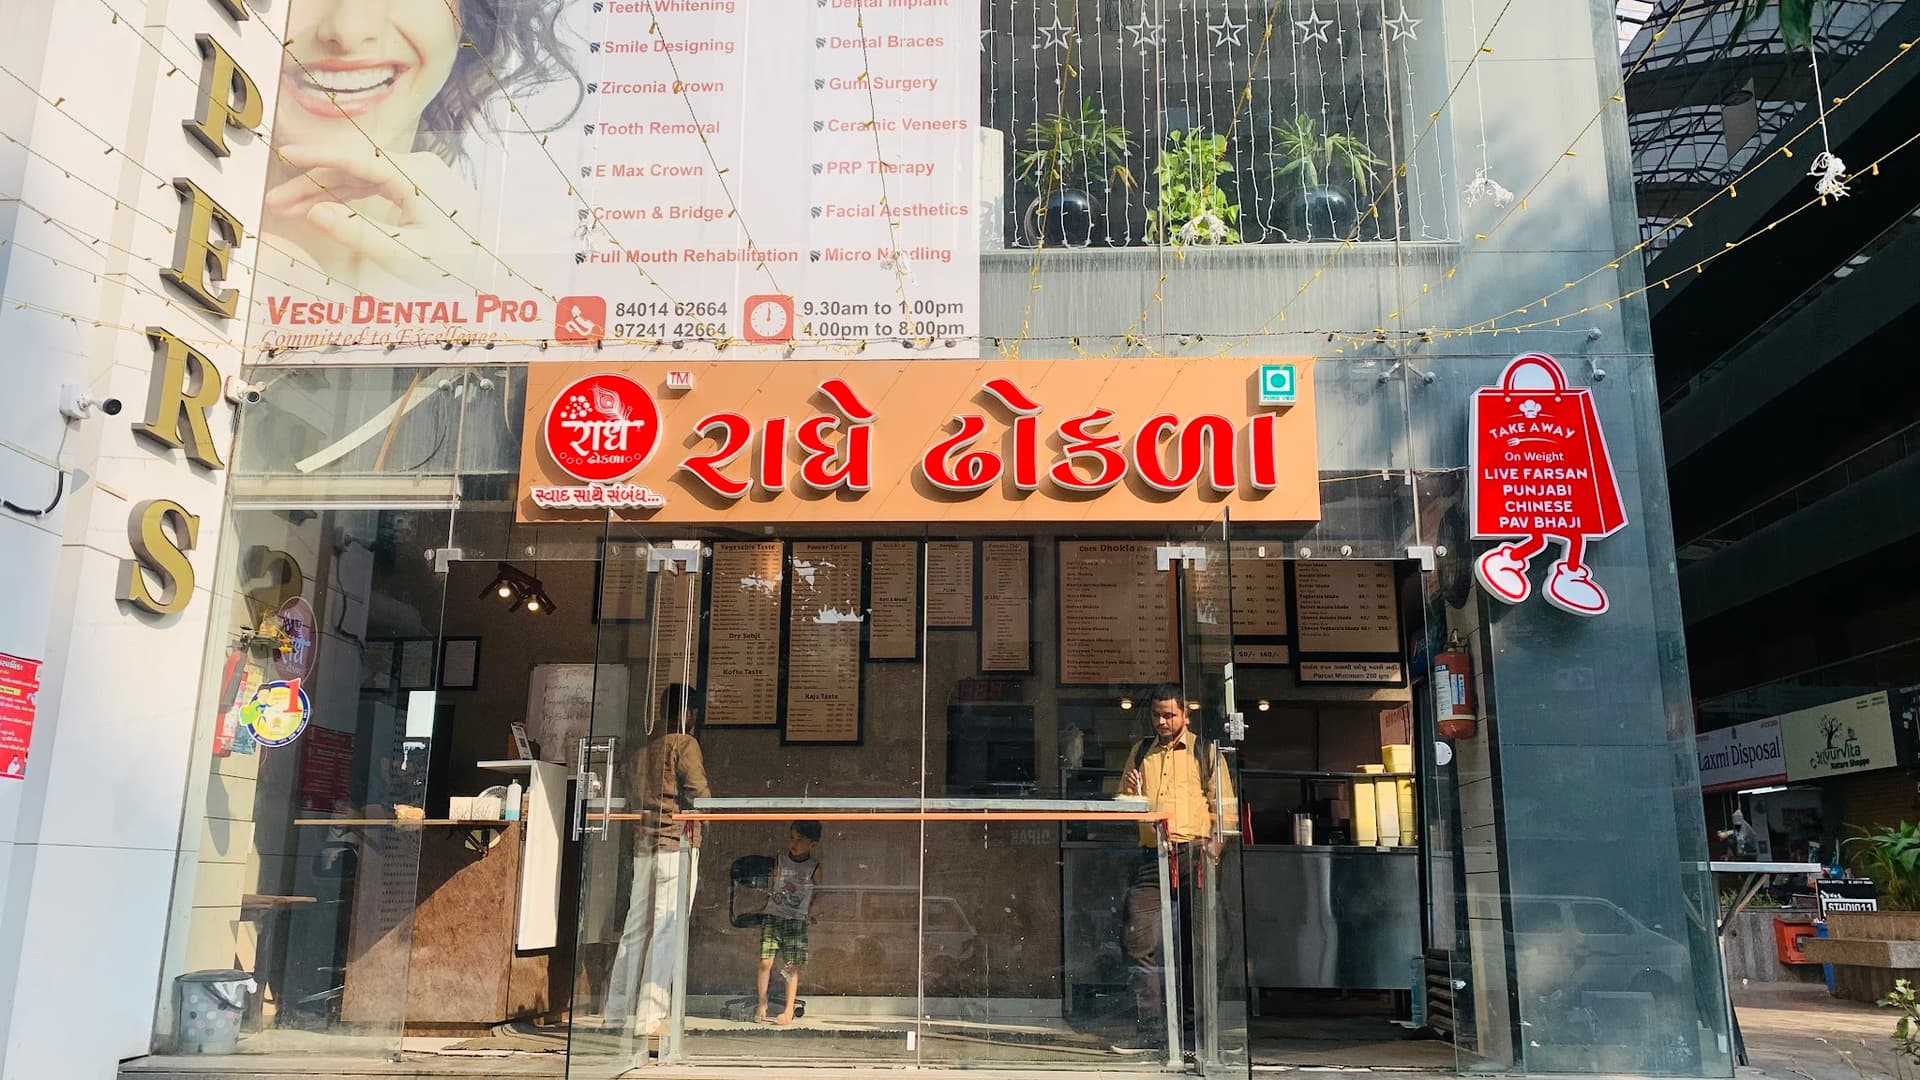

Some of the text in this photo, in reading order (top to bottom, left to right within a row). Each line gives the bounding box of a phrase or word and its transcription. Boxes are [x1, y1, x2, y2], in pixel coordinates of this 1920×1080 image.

[608, 0, 735, 14] Teeth Whitening
[831, 0, 948, 10] Dental Implant
[604, 39, 735, 55] Smile Designing
[830, 35, 944, 48] Dental Braces
[601, 81, 667, 95] Zirconia
[829, 76, 938, 92] Gum Surgery
[599, 121, 720, 136] Tooth Removal
[828, 118, 968, 132] Ceramic Veneers
[596, 164, 704, 177] E Max Crown
[827, 161, 936, 176] PRP Therapy
[593, 206, 724, 222] Crown & Bridge
[826, 203, 969, 218] Facial Aesthetics
[590, 248, 798, 263] Full Mouth Rehabilitation
[825, 247, 951, 263] Micro Ndling
[615, 302, 728, 317] 84014 62664
[804, 300, 964, 318] 9.30am to 1.00pm
[261, 326, 368, 347] Committed
[614, 322, 727, 338] 97241 42664
[804, 321, 965, 338] 4.00pm to 8.00pm
[670, 372, 689, 384] TM
[679, 377, 1279, 499] રાધે ઢોકળા
[1489, 422, 1576, 440] TAKE AWAY
[1504, 451, 1564, 464] On Weight
[1484, 468, 1588, 480] LIVE FARSAN
[535, 488, 570, 504] સ્વાદ
[1503, 484, 1572, 496] PUNJABI
[1505, 500, 1573, 512] CHINESE
[1499, 516, 1582, 528] PAV BHAJI
[1100, 544, 1135, 552] Dhokla
[1698, 736, 1781, 772] Laxmi Disposal
